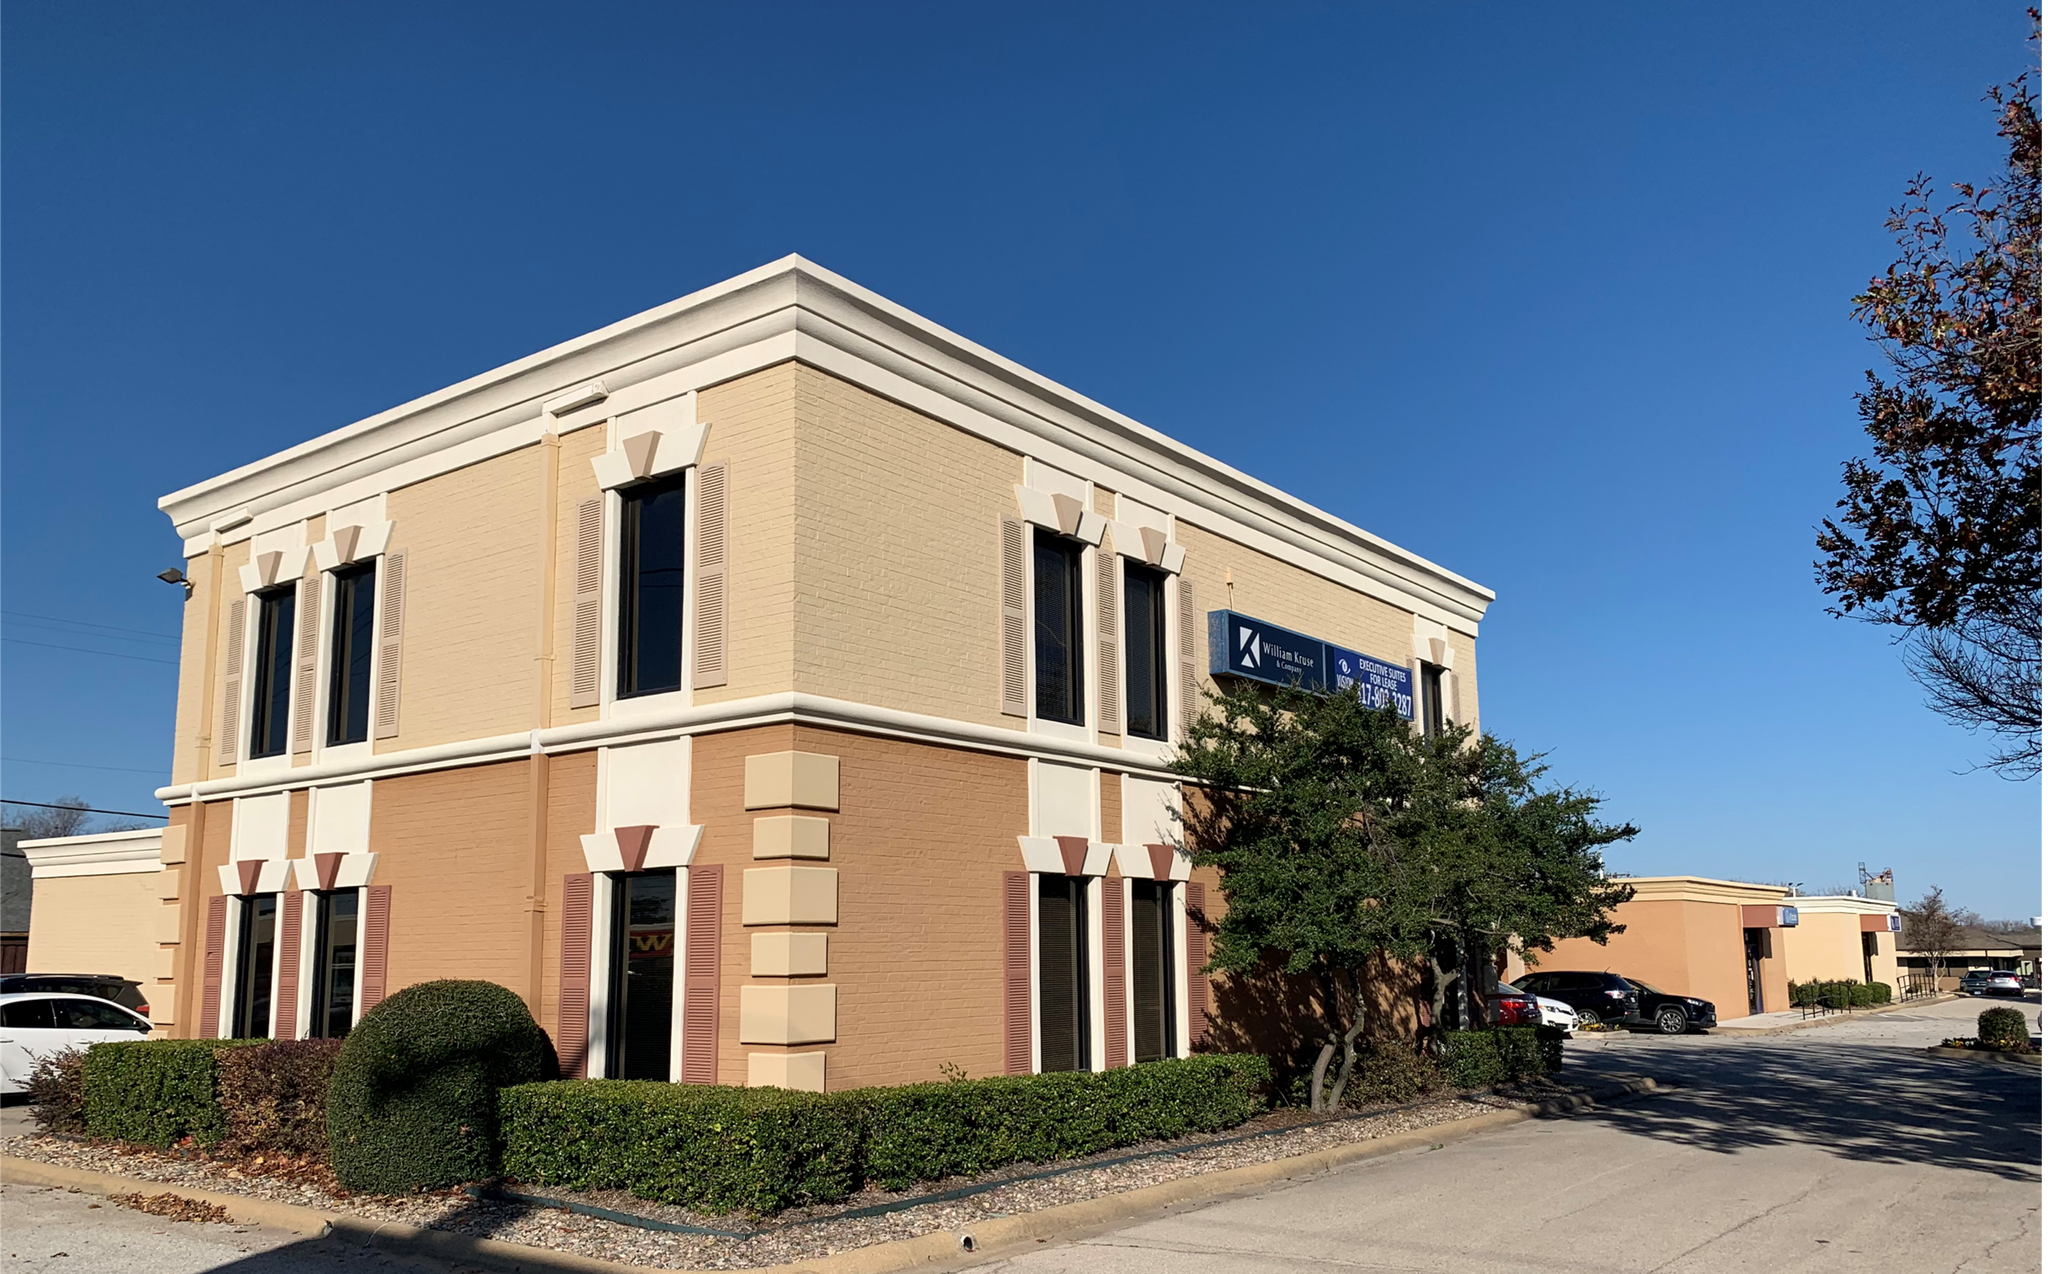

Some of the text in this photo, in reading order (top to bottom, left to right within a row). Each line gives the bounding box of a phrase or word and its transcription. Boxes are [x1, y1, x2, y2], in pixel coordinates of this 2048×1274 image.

[1262, 641, 1314, 668] William Kruse
[1276, 660, 1302, 675] & Company
[1359, 658, 1407, 683] EXECUTIVE SUITES
[1370, 673, 1398, 691] FOR LEASE
